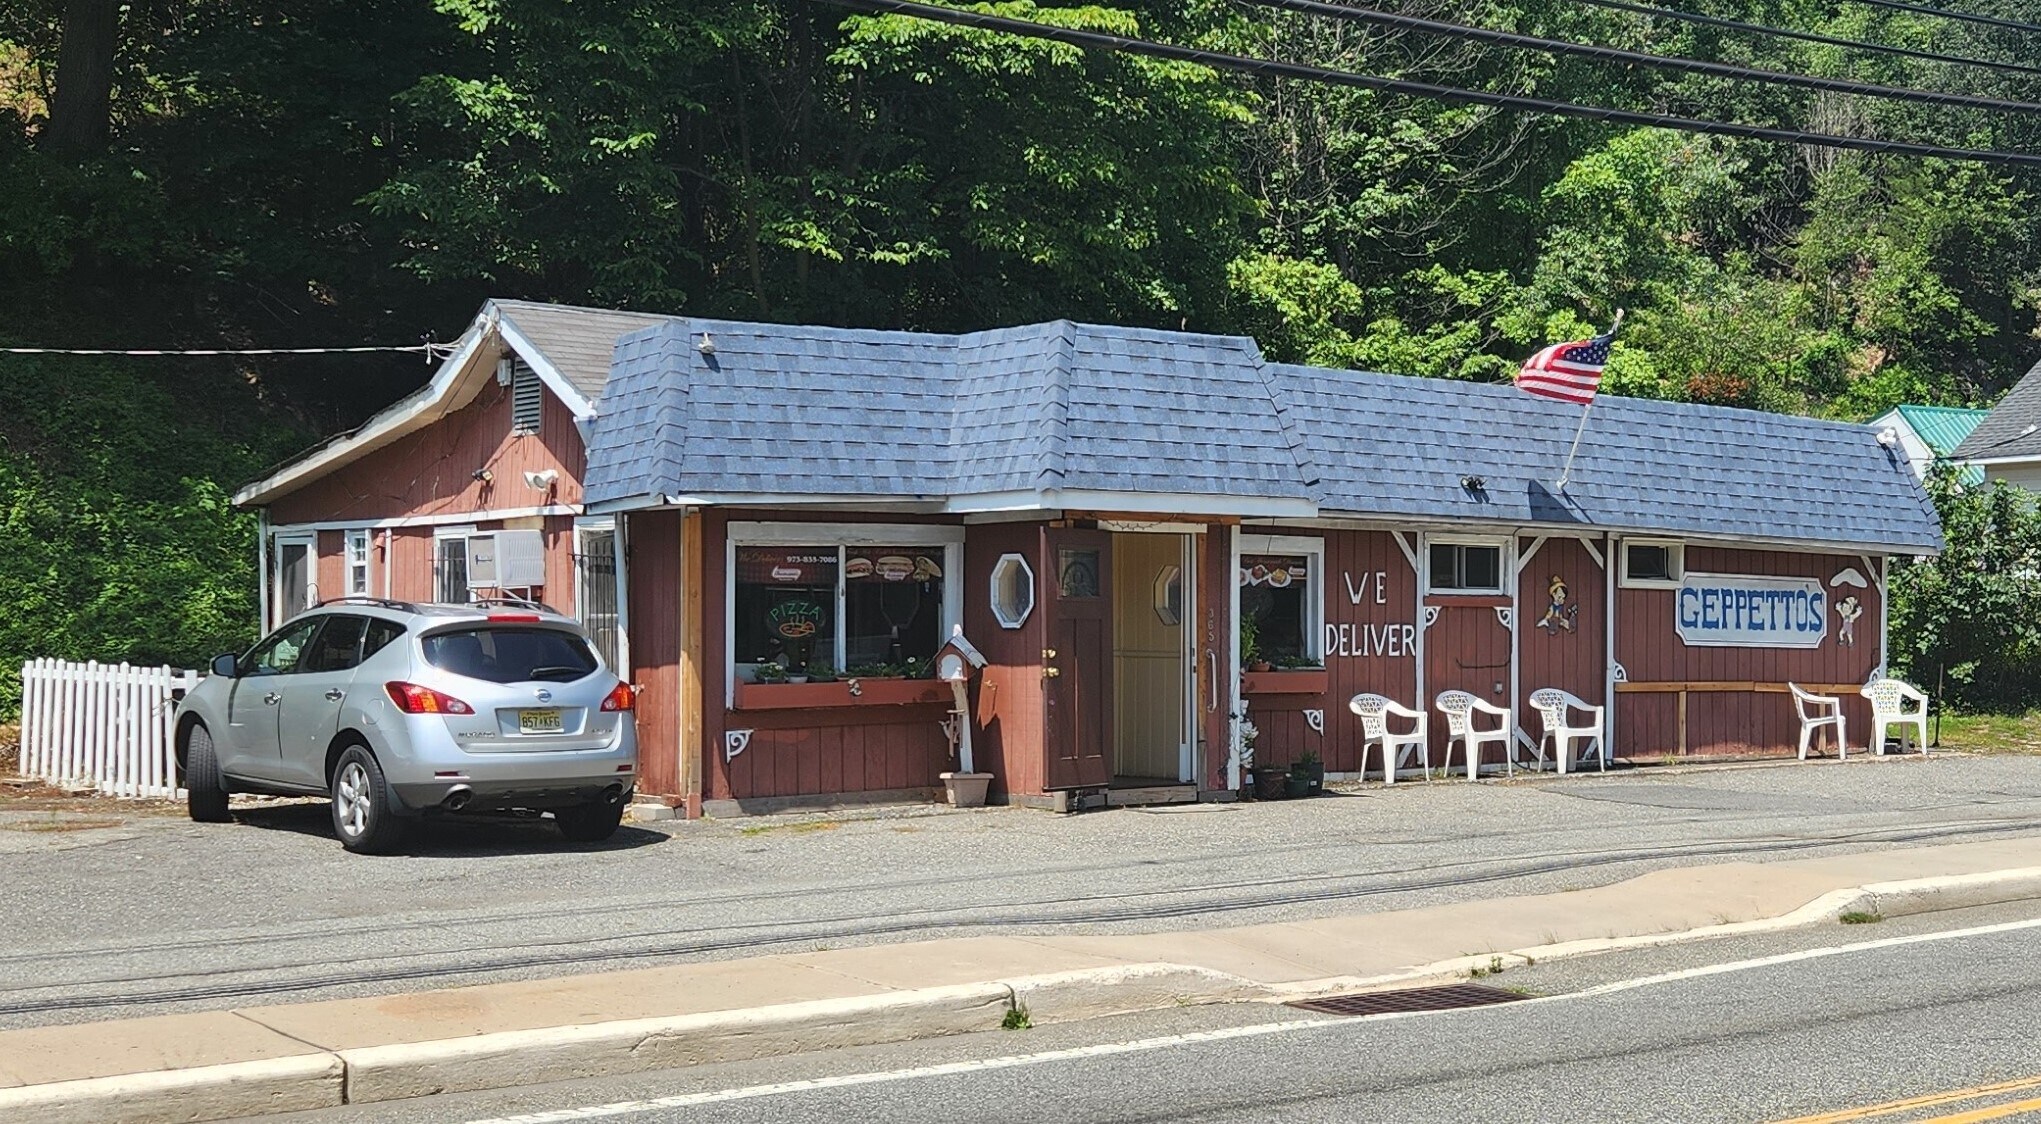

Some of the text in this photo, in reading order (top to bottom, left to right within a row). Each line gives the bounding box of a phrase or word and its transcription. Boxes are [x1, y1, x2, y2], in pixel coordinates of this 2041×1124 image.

[1344, 571, 1386, 604] WE
[770, 602, 819, 621] PIZZA
[1325, 623, 1416, 657] DELIVER
